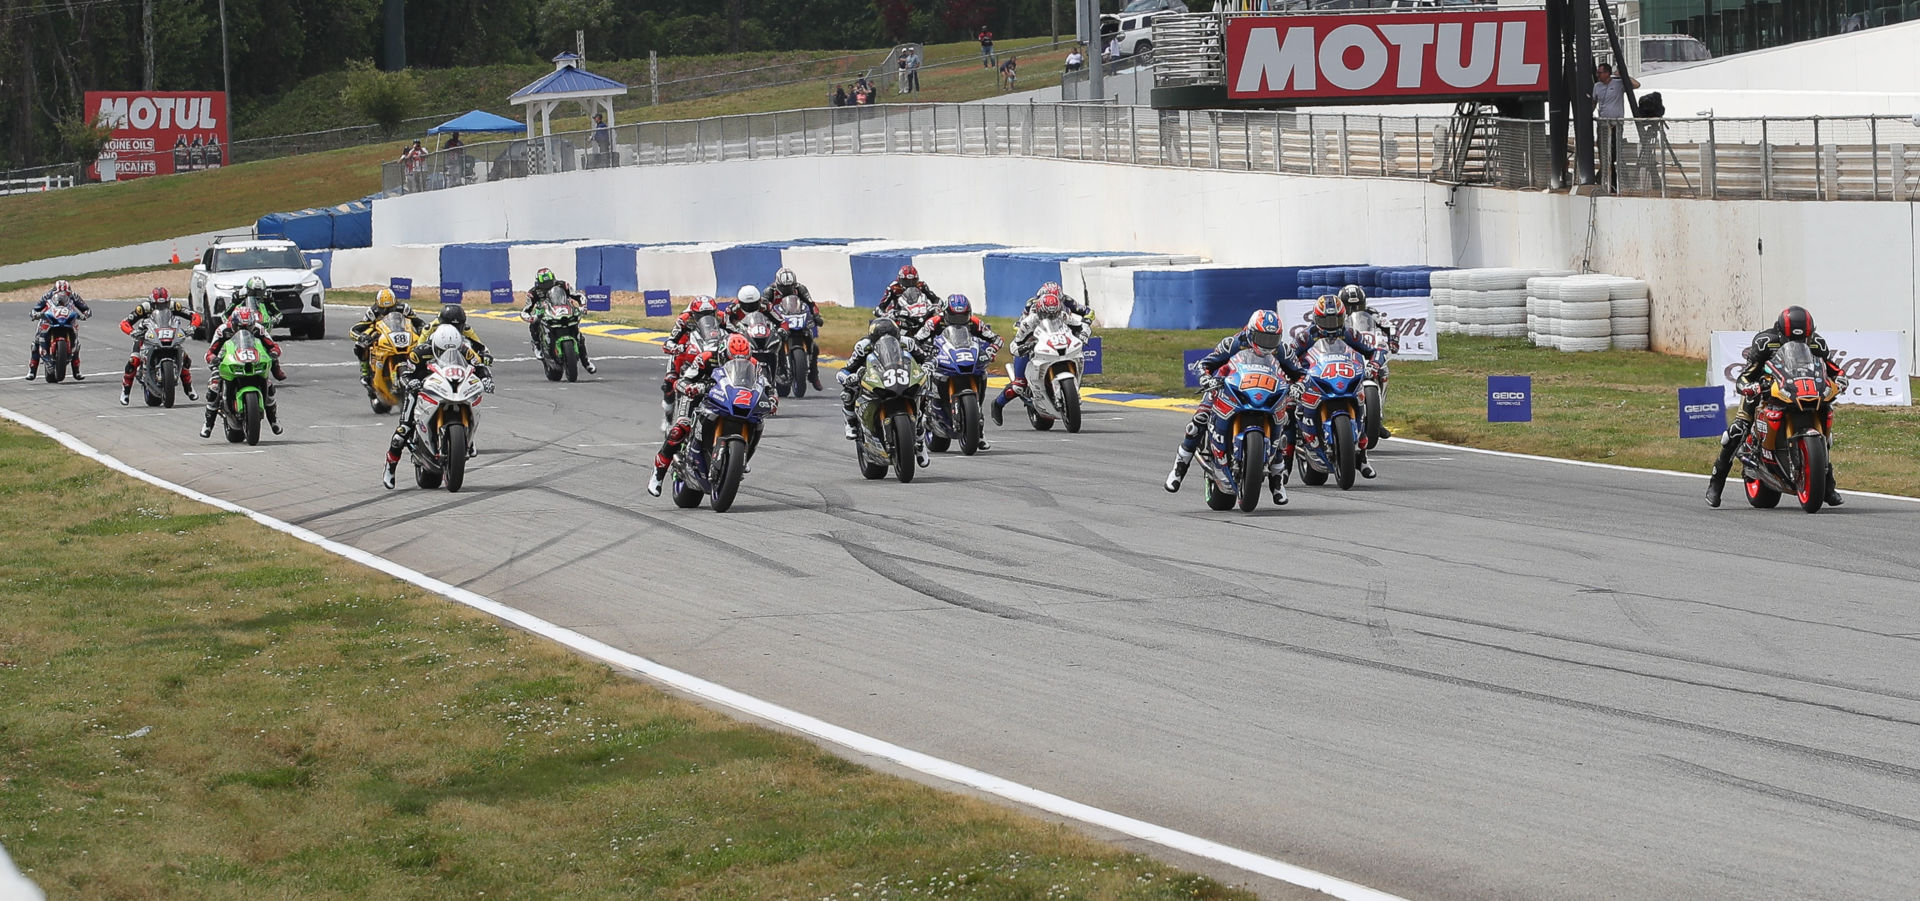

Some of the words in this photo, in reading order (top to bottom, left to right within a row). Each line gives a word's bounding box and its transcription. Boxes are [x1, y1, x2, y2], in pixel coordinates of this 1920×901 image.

[1235, 21, 1541, 92] MOTUL
[96, 96, 217, 130] MOTUL
[103, 140, 131, 150] NGINE
[132, 140, 153, 150] OILS
[54, 307, 69, 316] 79
[788, 317, 804, 329] 31
[157, 329, 174, 339] 19
[237, 350, 256, 361] 65
[955, 351, 975, 363] 32
[1320, 362, 1355, 379] 45
[882, 368, 910, 388] 33
[1240, 372, 1278, 393] 50
[1793, 379, 1819, 397] 11
[732, 389, 753, 406] 2
[1492, 391, 1525, 400] GEICO
[1684, 403, 1720, 413] GEICO
